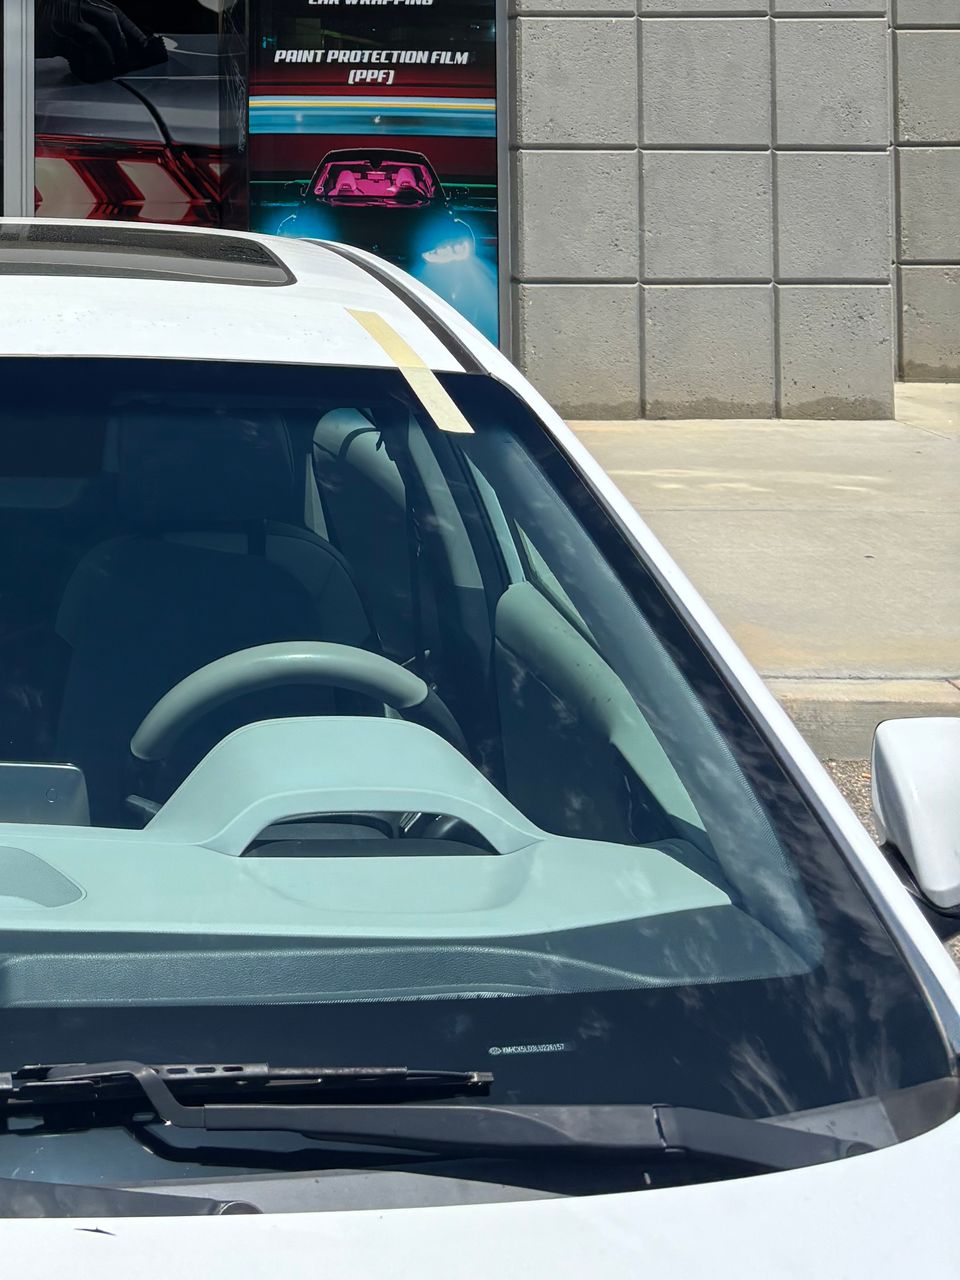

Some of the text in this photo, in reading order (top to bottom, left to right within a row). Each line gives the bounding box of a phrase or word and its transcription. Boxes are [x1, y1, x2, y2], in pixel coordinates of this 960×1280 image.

[274, 50, 469, 65] PAINT PROTECTION FILM
